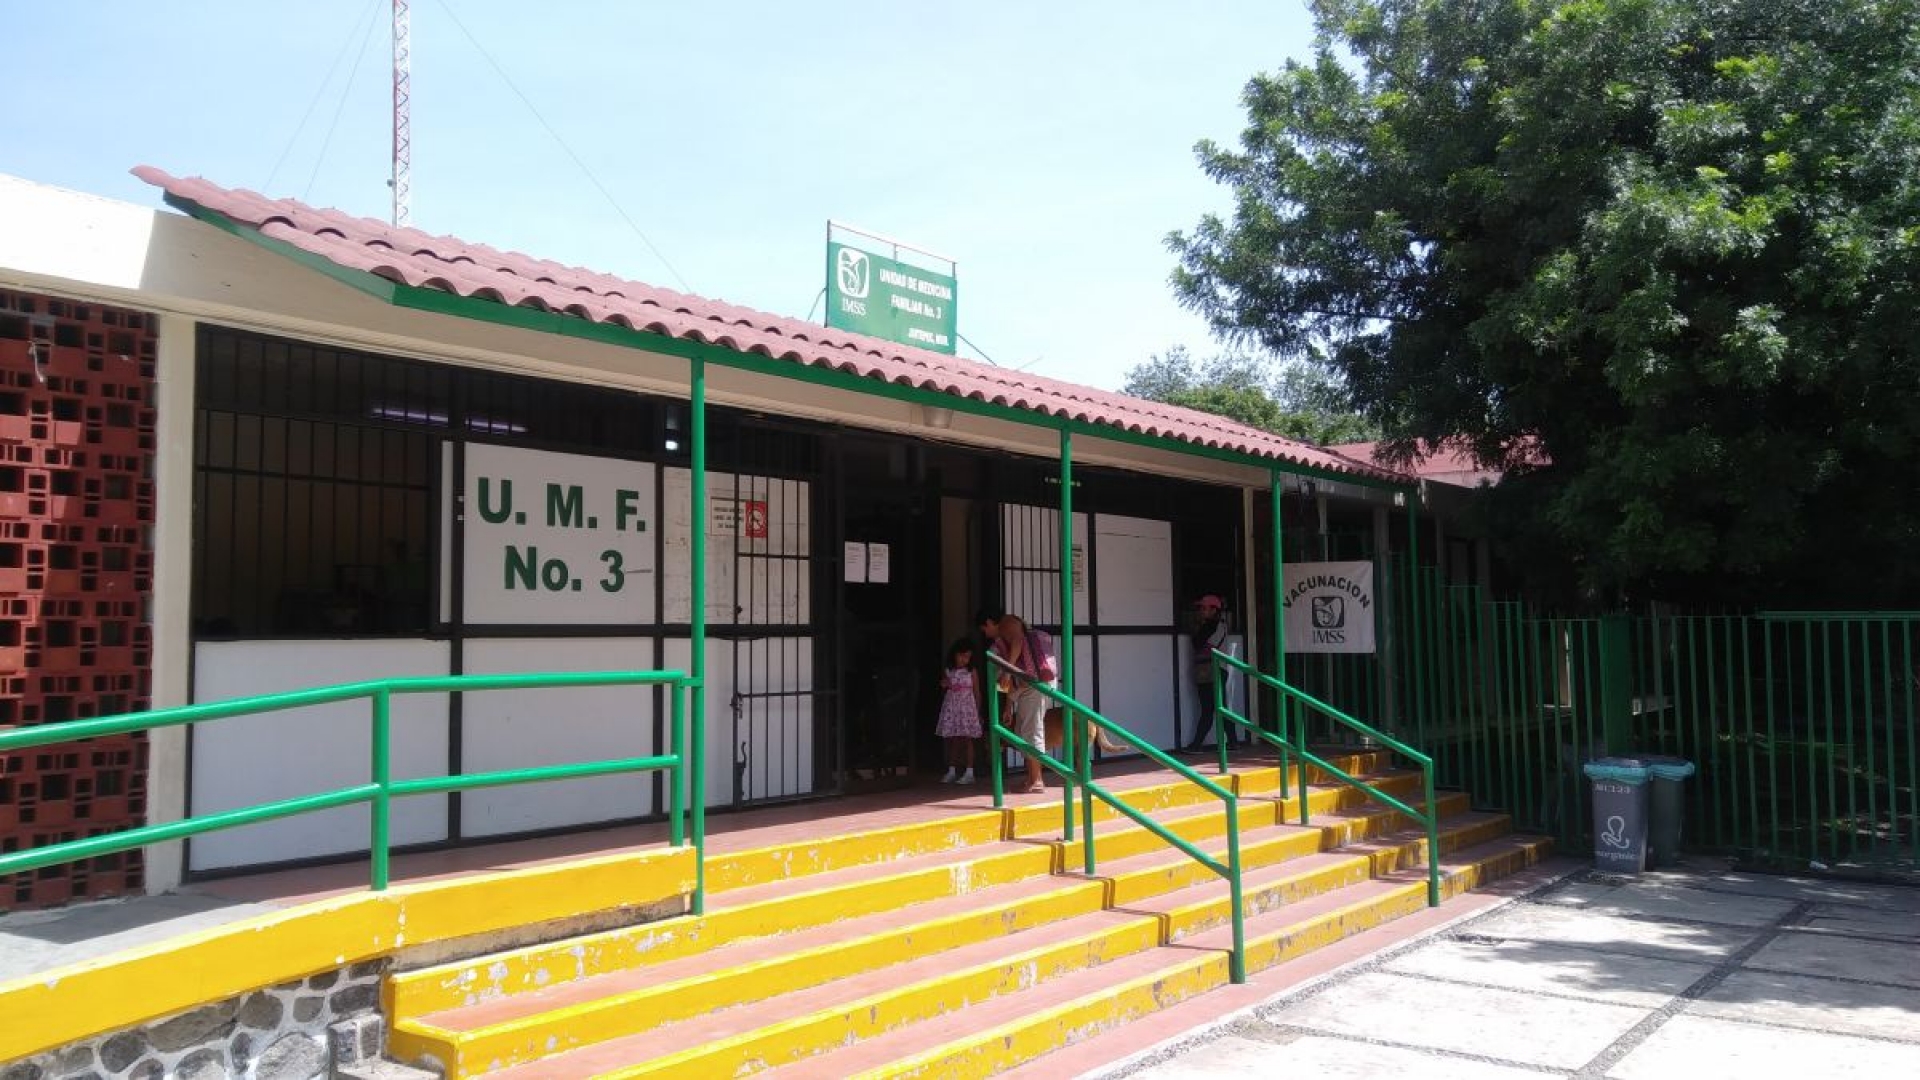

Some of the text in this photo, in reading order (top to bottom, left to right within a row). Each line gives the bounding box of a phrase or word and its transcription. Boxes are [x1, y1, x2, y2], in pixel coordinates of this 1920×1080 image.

[907, 276, 918, 291] DE
[842, 298, 866, 316] IMSS
[478, 477, 646, 532] U. M. F.
[504, 545, 625, 592] No. 3
[1282, 575, 1371, 609] VACUNACION
[1312, 629, 1345, 644] IMSS
